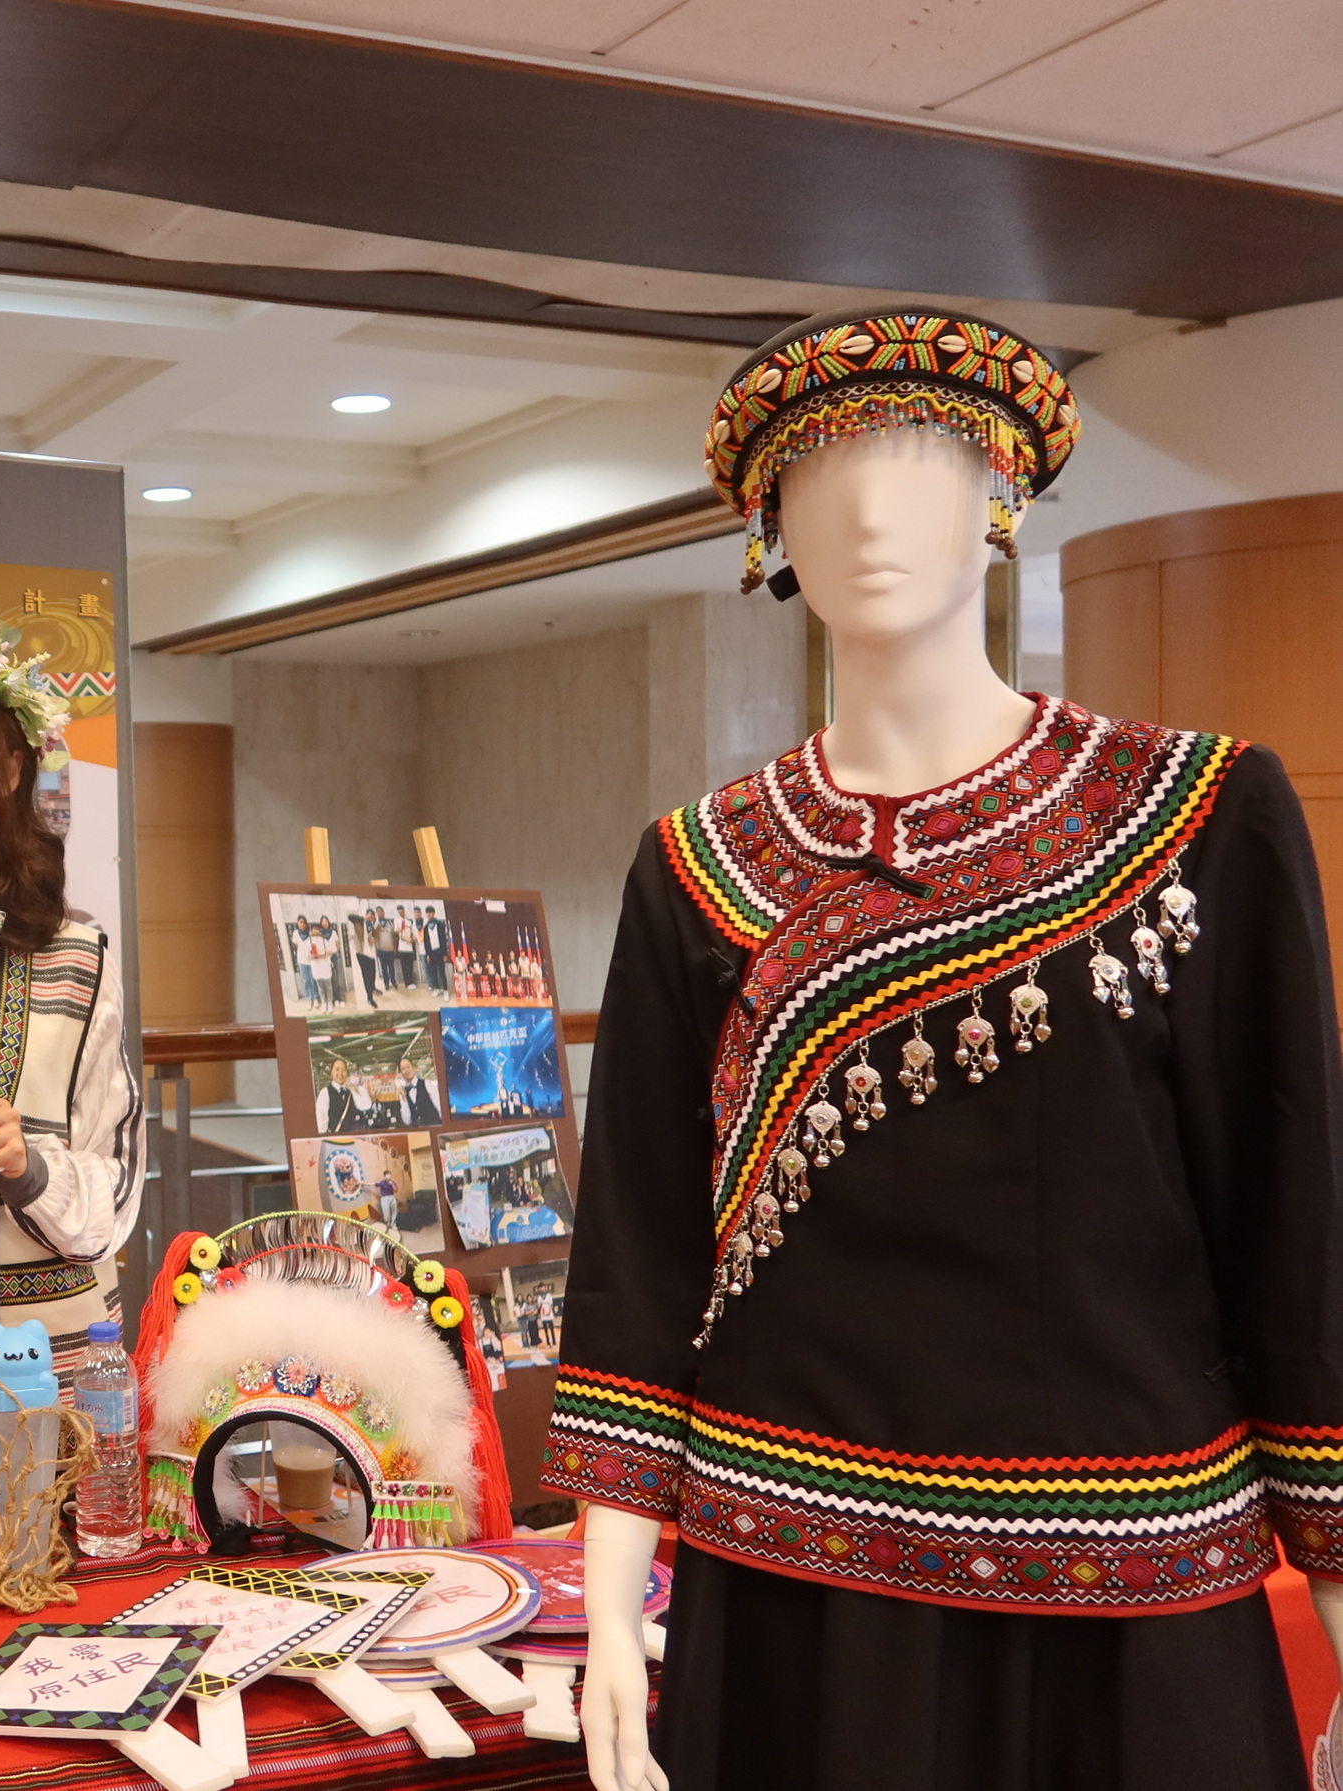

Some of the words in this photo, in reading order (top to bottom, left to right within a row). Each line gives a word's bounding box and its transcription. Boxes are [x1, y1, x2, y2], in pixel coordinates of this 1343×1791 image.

[18, 1643, 105, 1677] 我愛
[30, 1651, 162, 1704] 原住民
